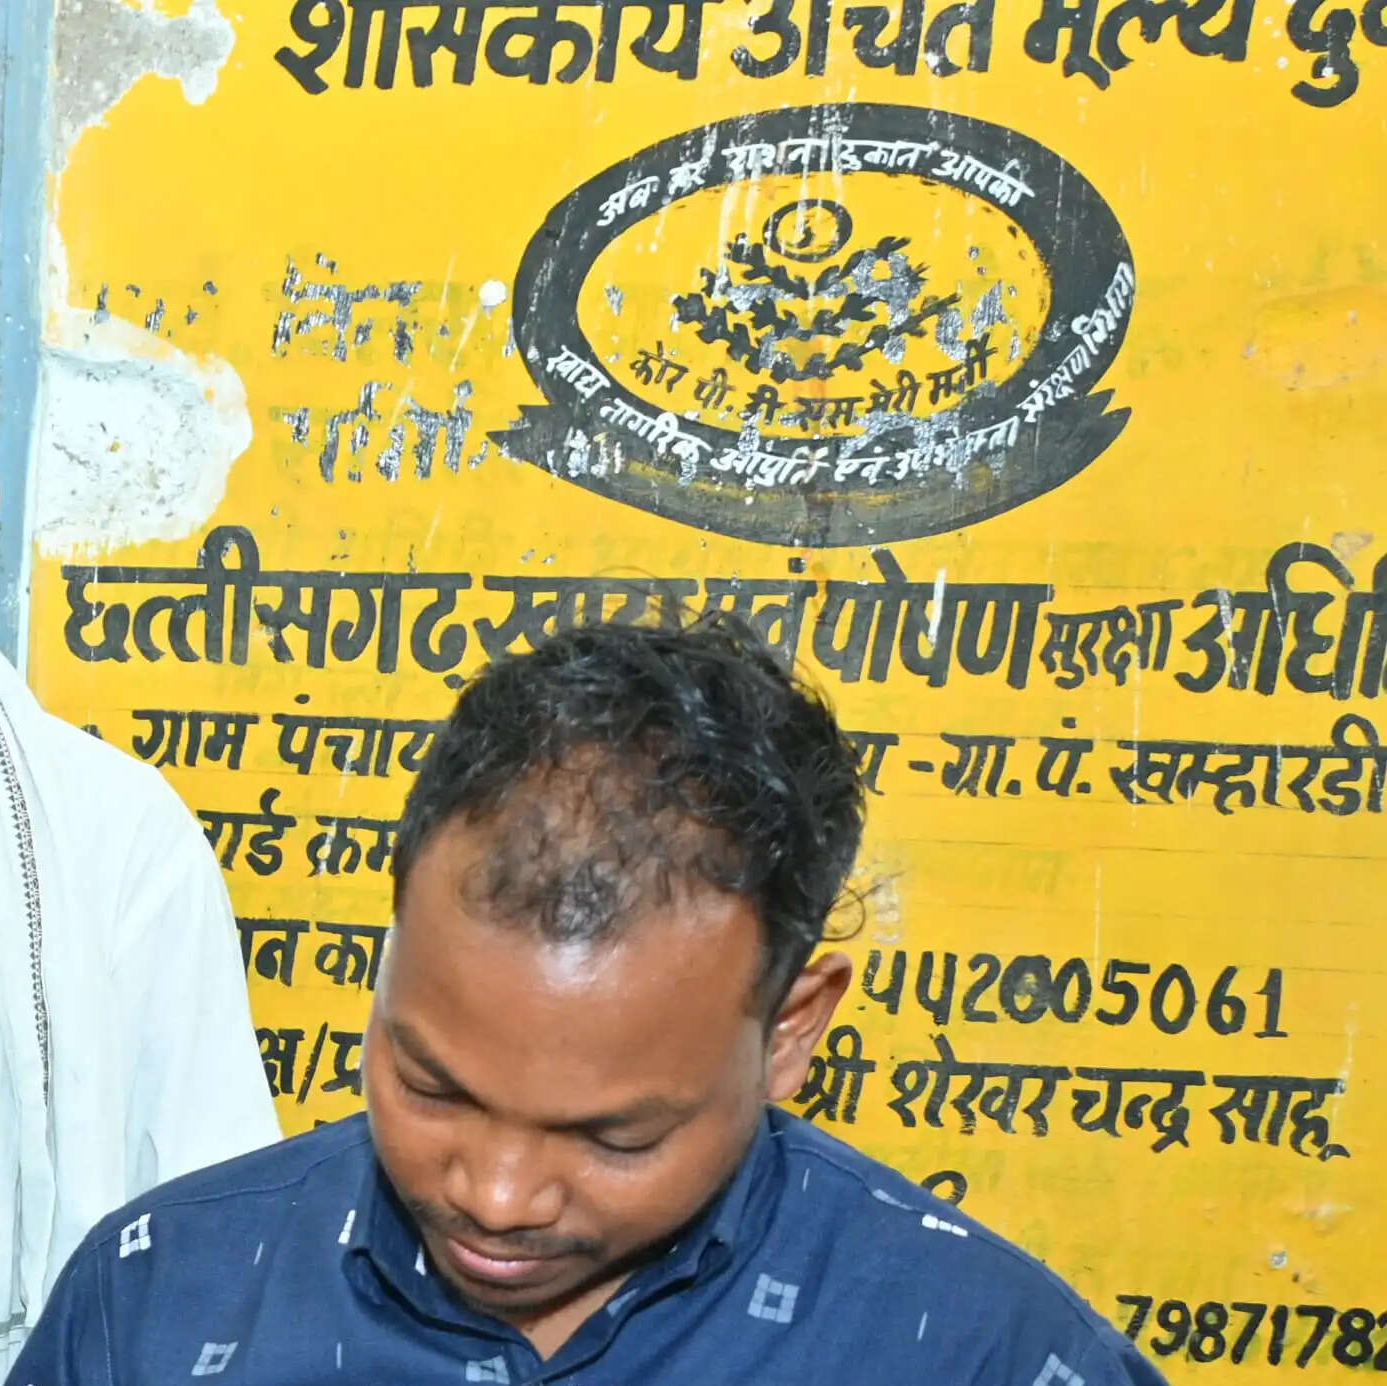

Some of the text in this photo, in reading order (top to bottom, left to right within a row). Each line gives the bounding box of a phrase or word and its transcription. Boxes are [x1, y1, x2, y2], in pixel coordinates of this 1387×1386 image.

[1284, 0, 1387, 107] दु
[61, 524, 473, 690] छत्तीसगढ़
[812, 547, 1055, 690] पोषण
[1039, 599, 1184, 689] सुरक्षा
[131, 709, 259, 770] ग्राम
